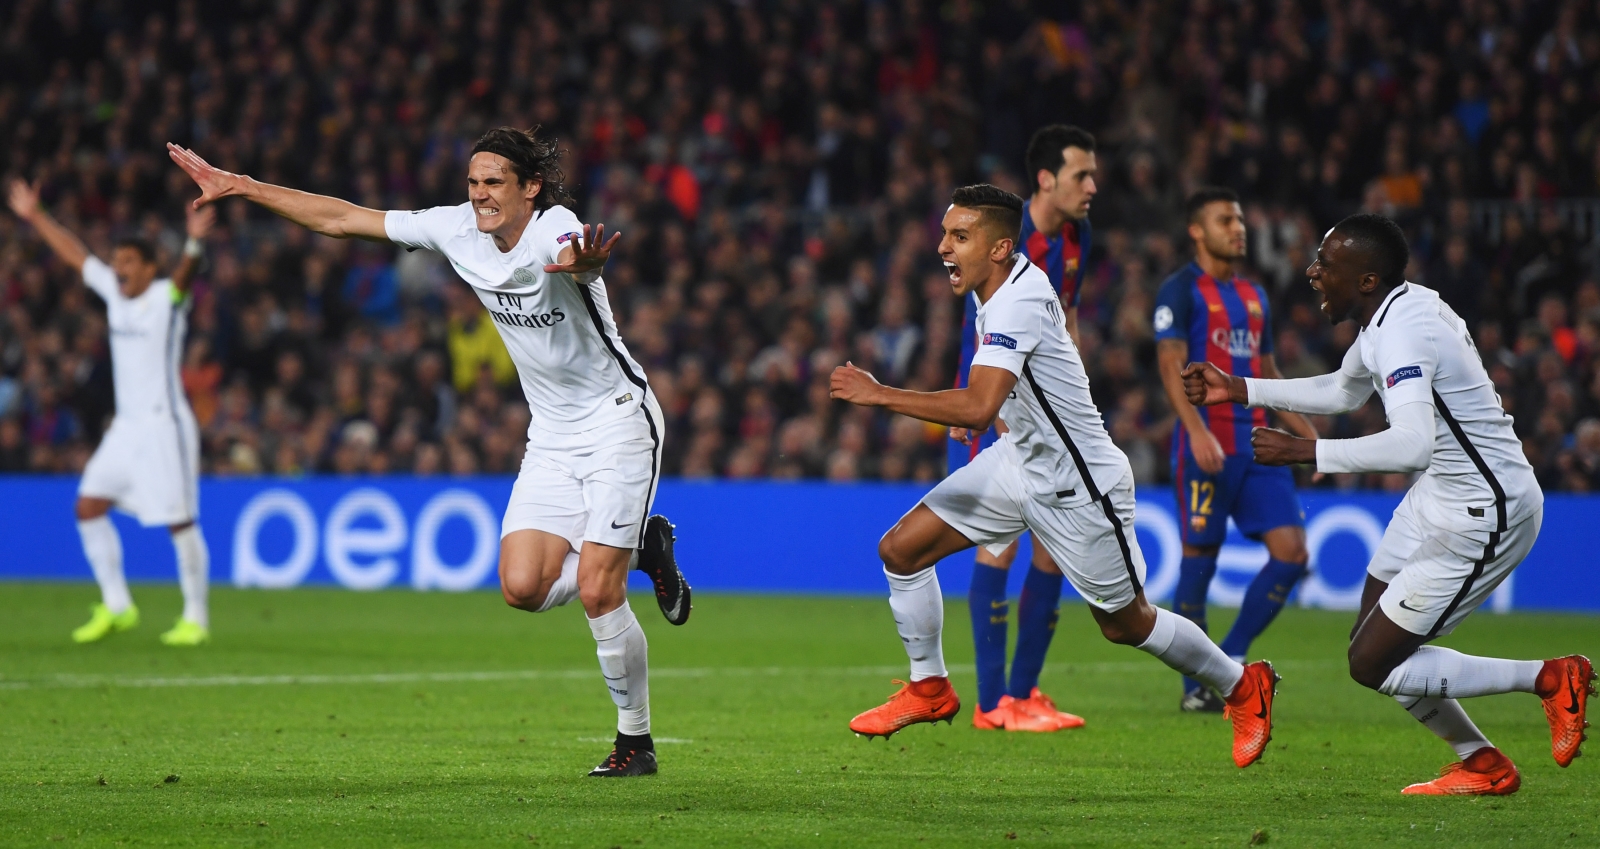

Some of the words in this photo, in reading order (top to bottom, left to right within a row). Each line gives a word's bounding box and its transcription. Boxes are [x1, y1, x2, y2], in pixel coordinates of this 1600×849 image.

[495, 293, 522, 310] Fly
[489, 307, 565, 328] mirates
[991, 335, 1017, 349] RESPECT
[1393, 368, 1421, 380] RESPECT
[1190, 480, 1214, 515] 12
[232, 487, 499, 591] pep
